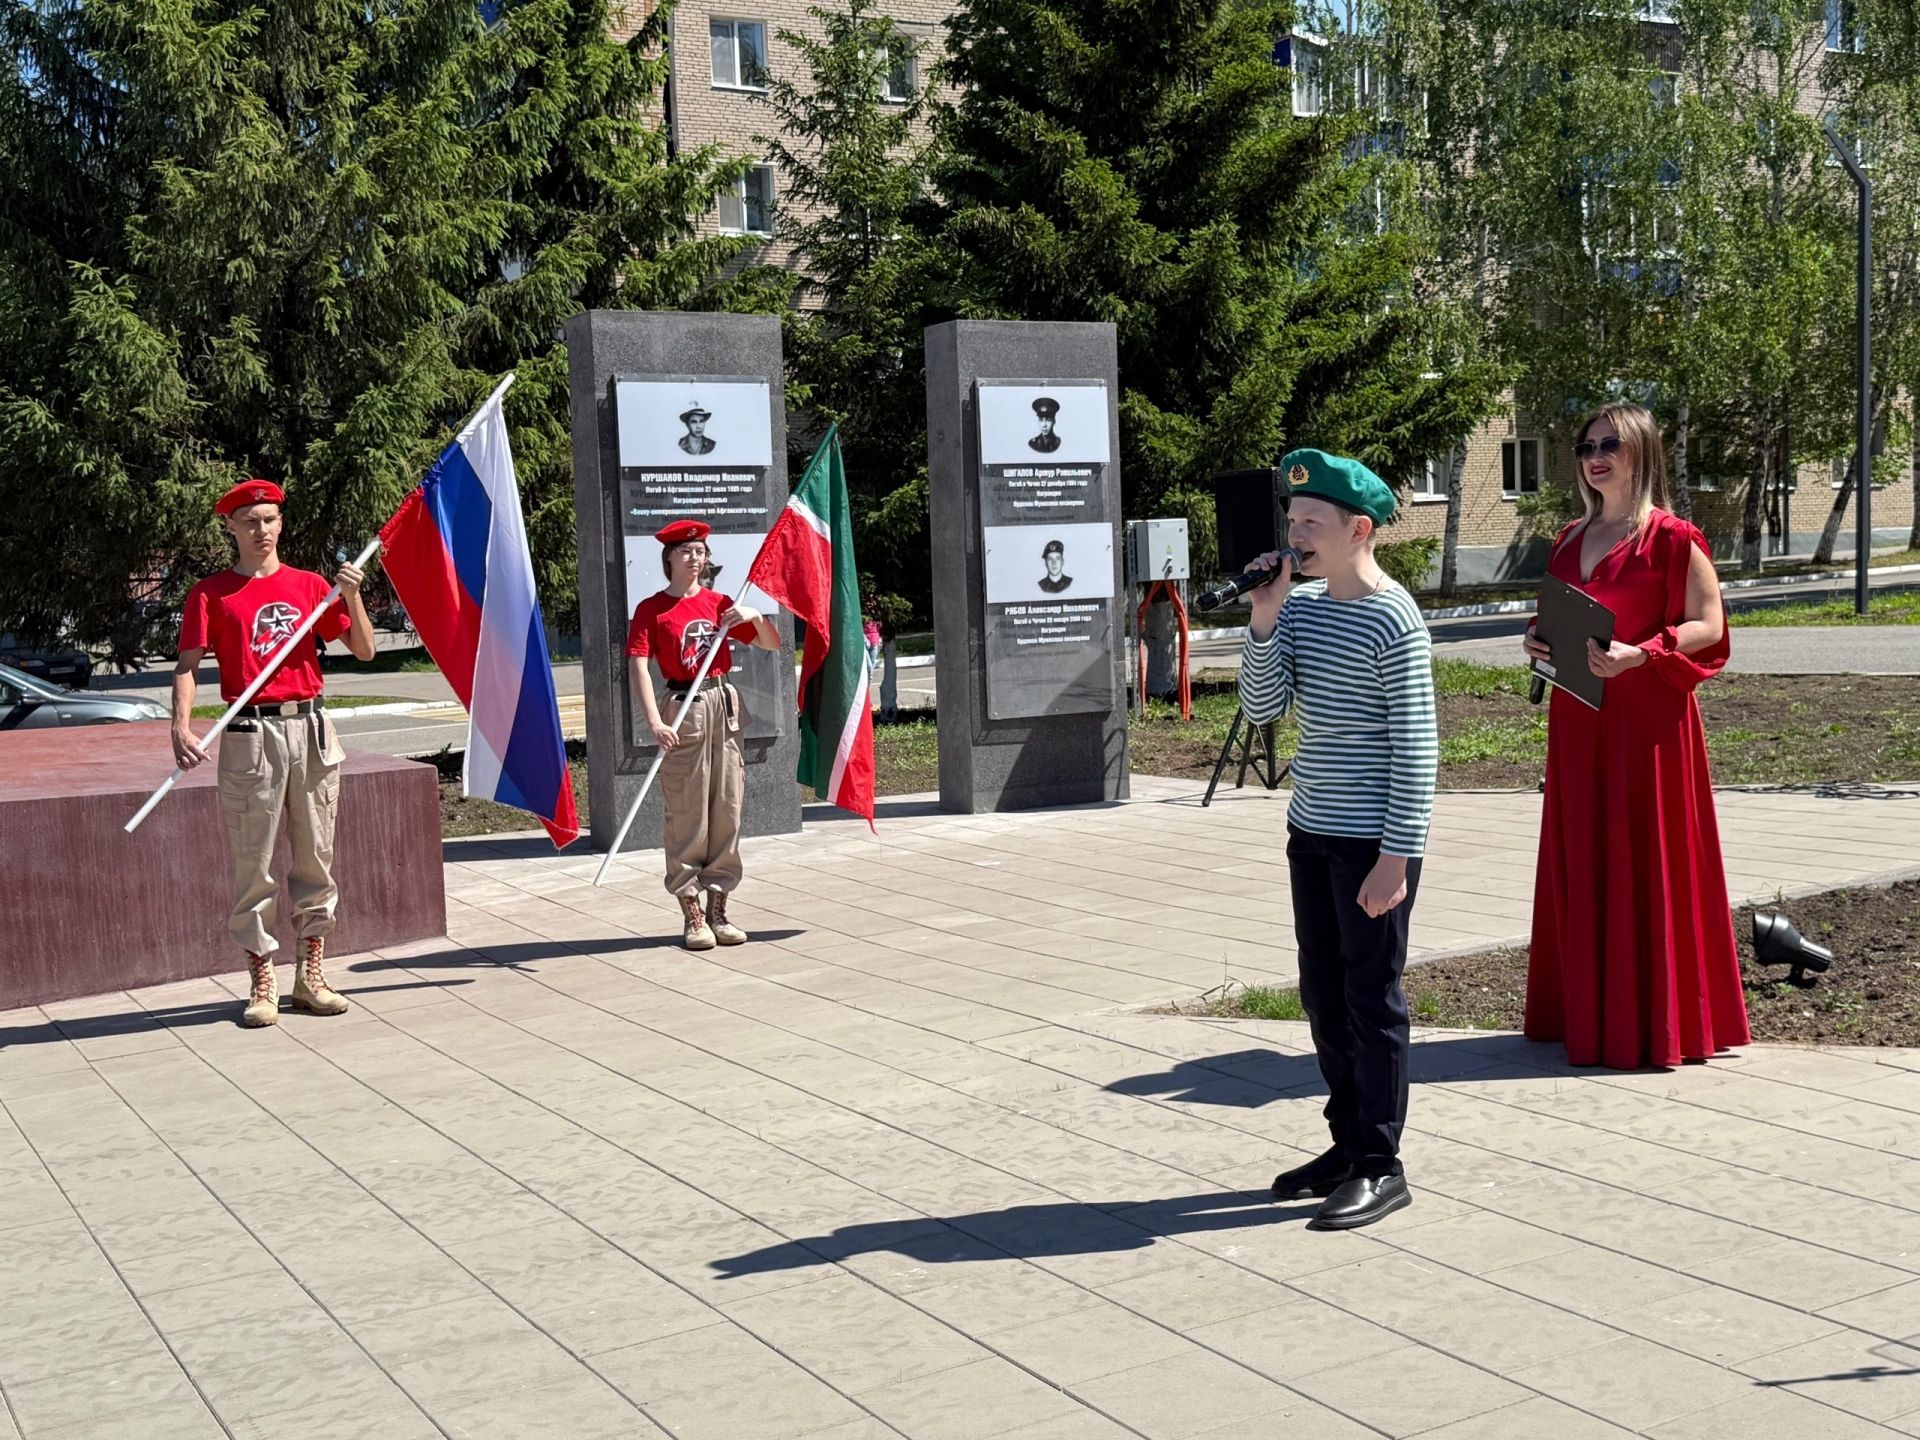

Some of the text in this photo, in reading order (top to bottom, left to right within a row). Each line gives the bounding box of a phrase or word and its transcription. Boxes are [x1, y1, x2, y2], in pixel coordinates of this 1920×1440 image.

[684, 473, 720, 483] Владимир
[722, 472, 756, 482] Иванович
[1034, 468, 1055, 478] Артур
[1005, 604, 1100, 615] РЯБОВ Александр Николаевич
